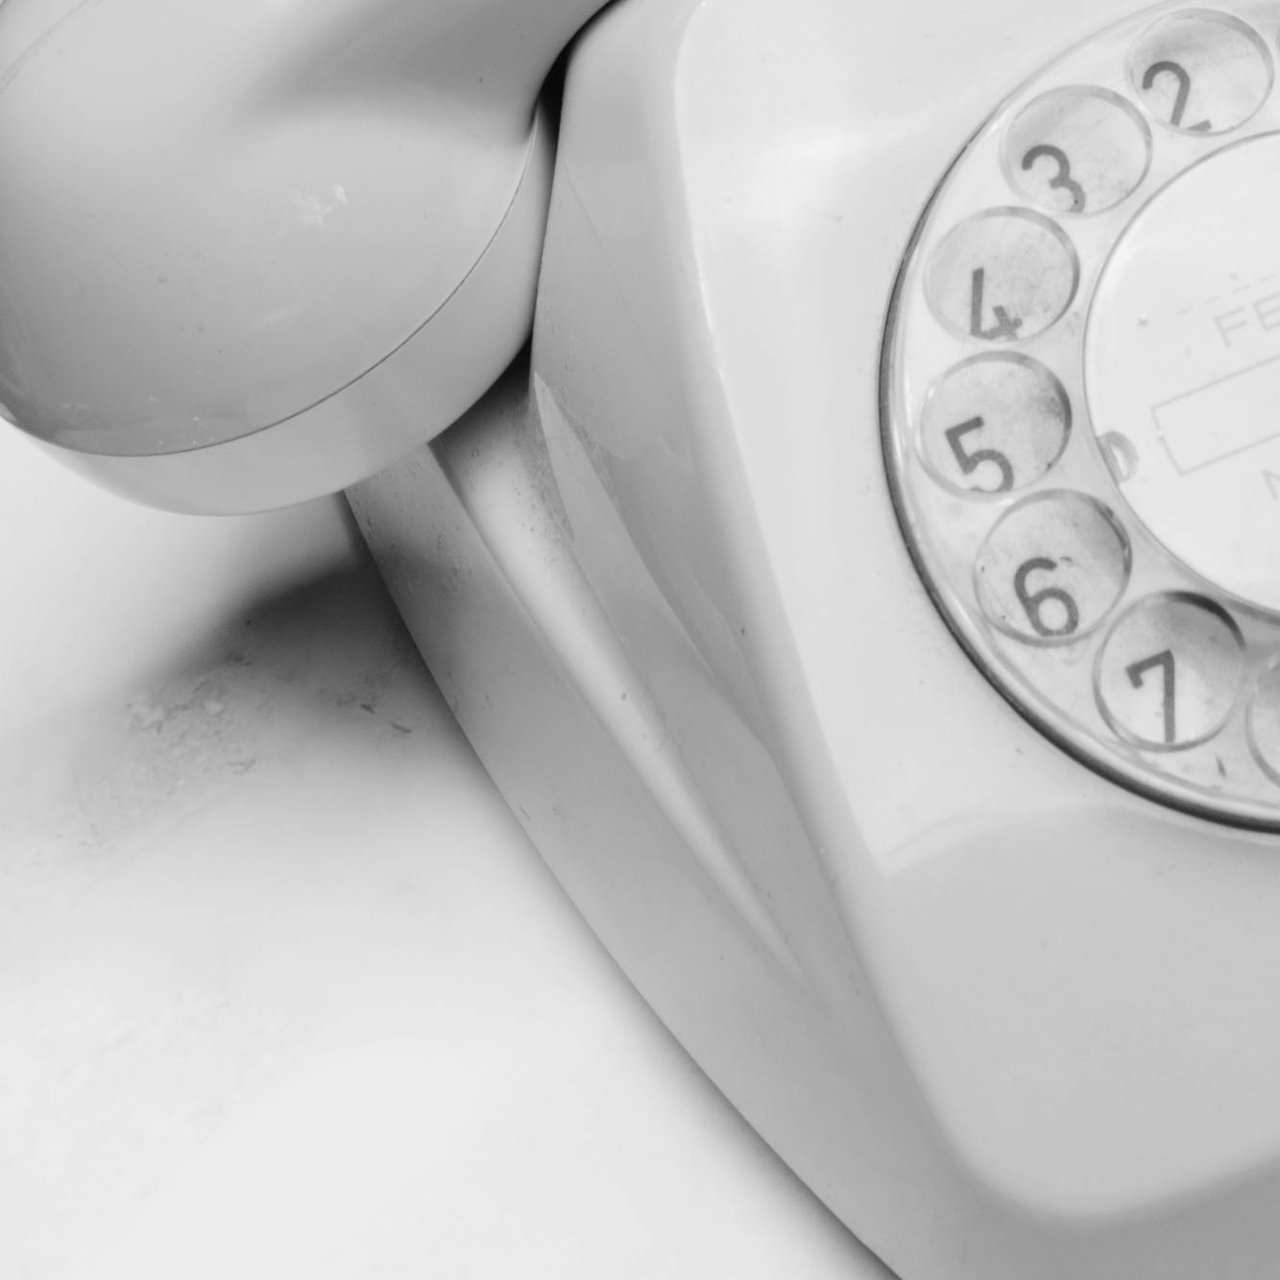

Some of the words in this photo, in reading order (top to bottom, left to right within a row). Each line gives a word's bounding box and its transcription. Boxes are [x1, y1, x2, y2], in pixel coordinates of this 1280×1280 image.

[1141, 60, 1213, 132] 2
[1021, 145, 1087, 212] 3
[968, 266, 1022, 340] 4
[944, 416, 1013, 492] 5
[1012, 557, 1080, 640] 6
[1126, 650, 1176, 744] 7
